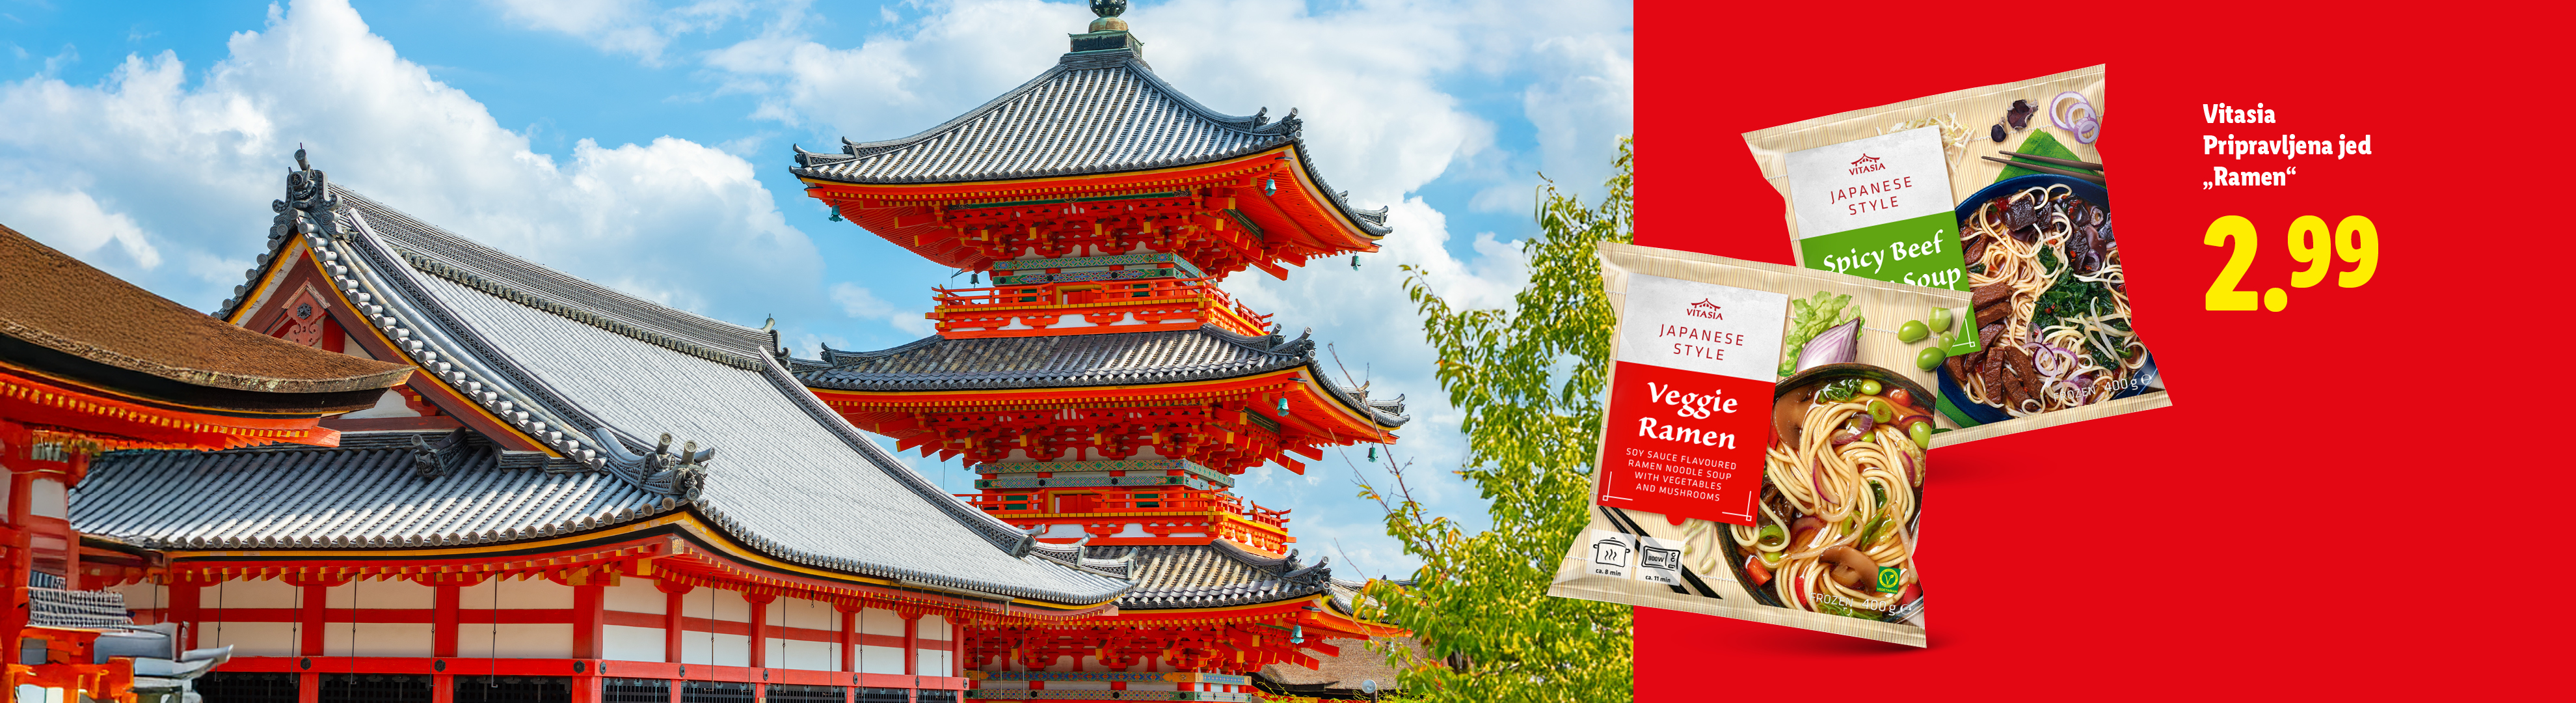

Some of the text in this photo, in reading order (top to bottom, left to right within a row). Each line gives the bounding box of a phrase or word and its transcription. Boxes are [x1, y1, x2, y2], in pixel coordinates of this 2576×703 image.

[1849, 163, 1886, 175] VITASIA
[1831, 176, 1912, 204] JAPANESE
[1849, 196, 1898, 215] STYLE
[1823, 229, 1943, 275] Spicy Beef
[1904, 268, 1961, 290] Soup
[1687, 309, 1723, 320] VITASIA
[1659, 324, 1744, 346] JAPANESE
[1673, 343, 1724, 361] STYLE
[1647, 381, 1738, 419] Veggie
[2053, 386, 2096, 402] FROZEN
[2104, 378, 2128, 392] 400
[1639, 417, 1736, 450] Ramen
[1626, 448, 1736, 470] SOY SAUCE FLAVOURED
[1628, 460, 1732, 480] RAMEN NOODLE SOUP
[1635, 471, 1722, 490] WITH VEGETABLES
[1636, 483, 1720, 502] AND MUSHROOMS
[1809, 592, 1853, 607] FROZEN
[1861, 599, 1886, 612] 400
